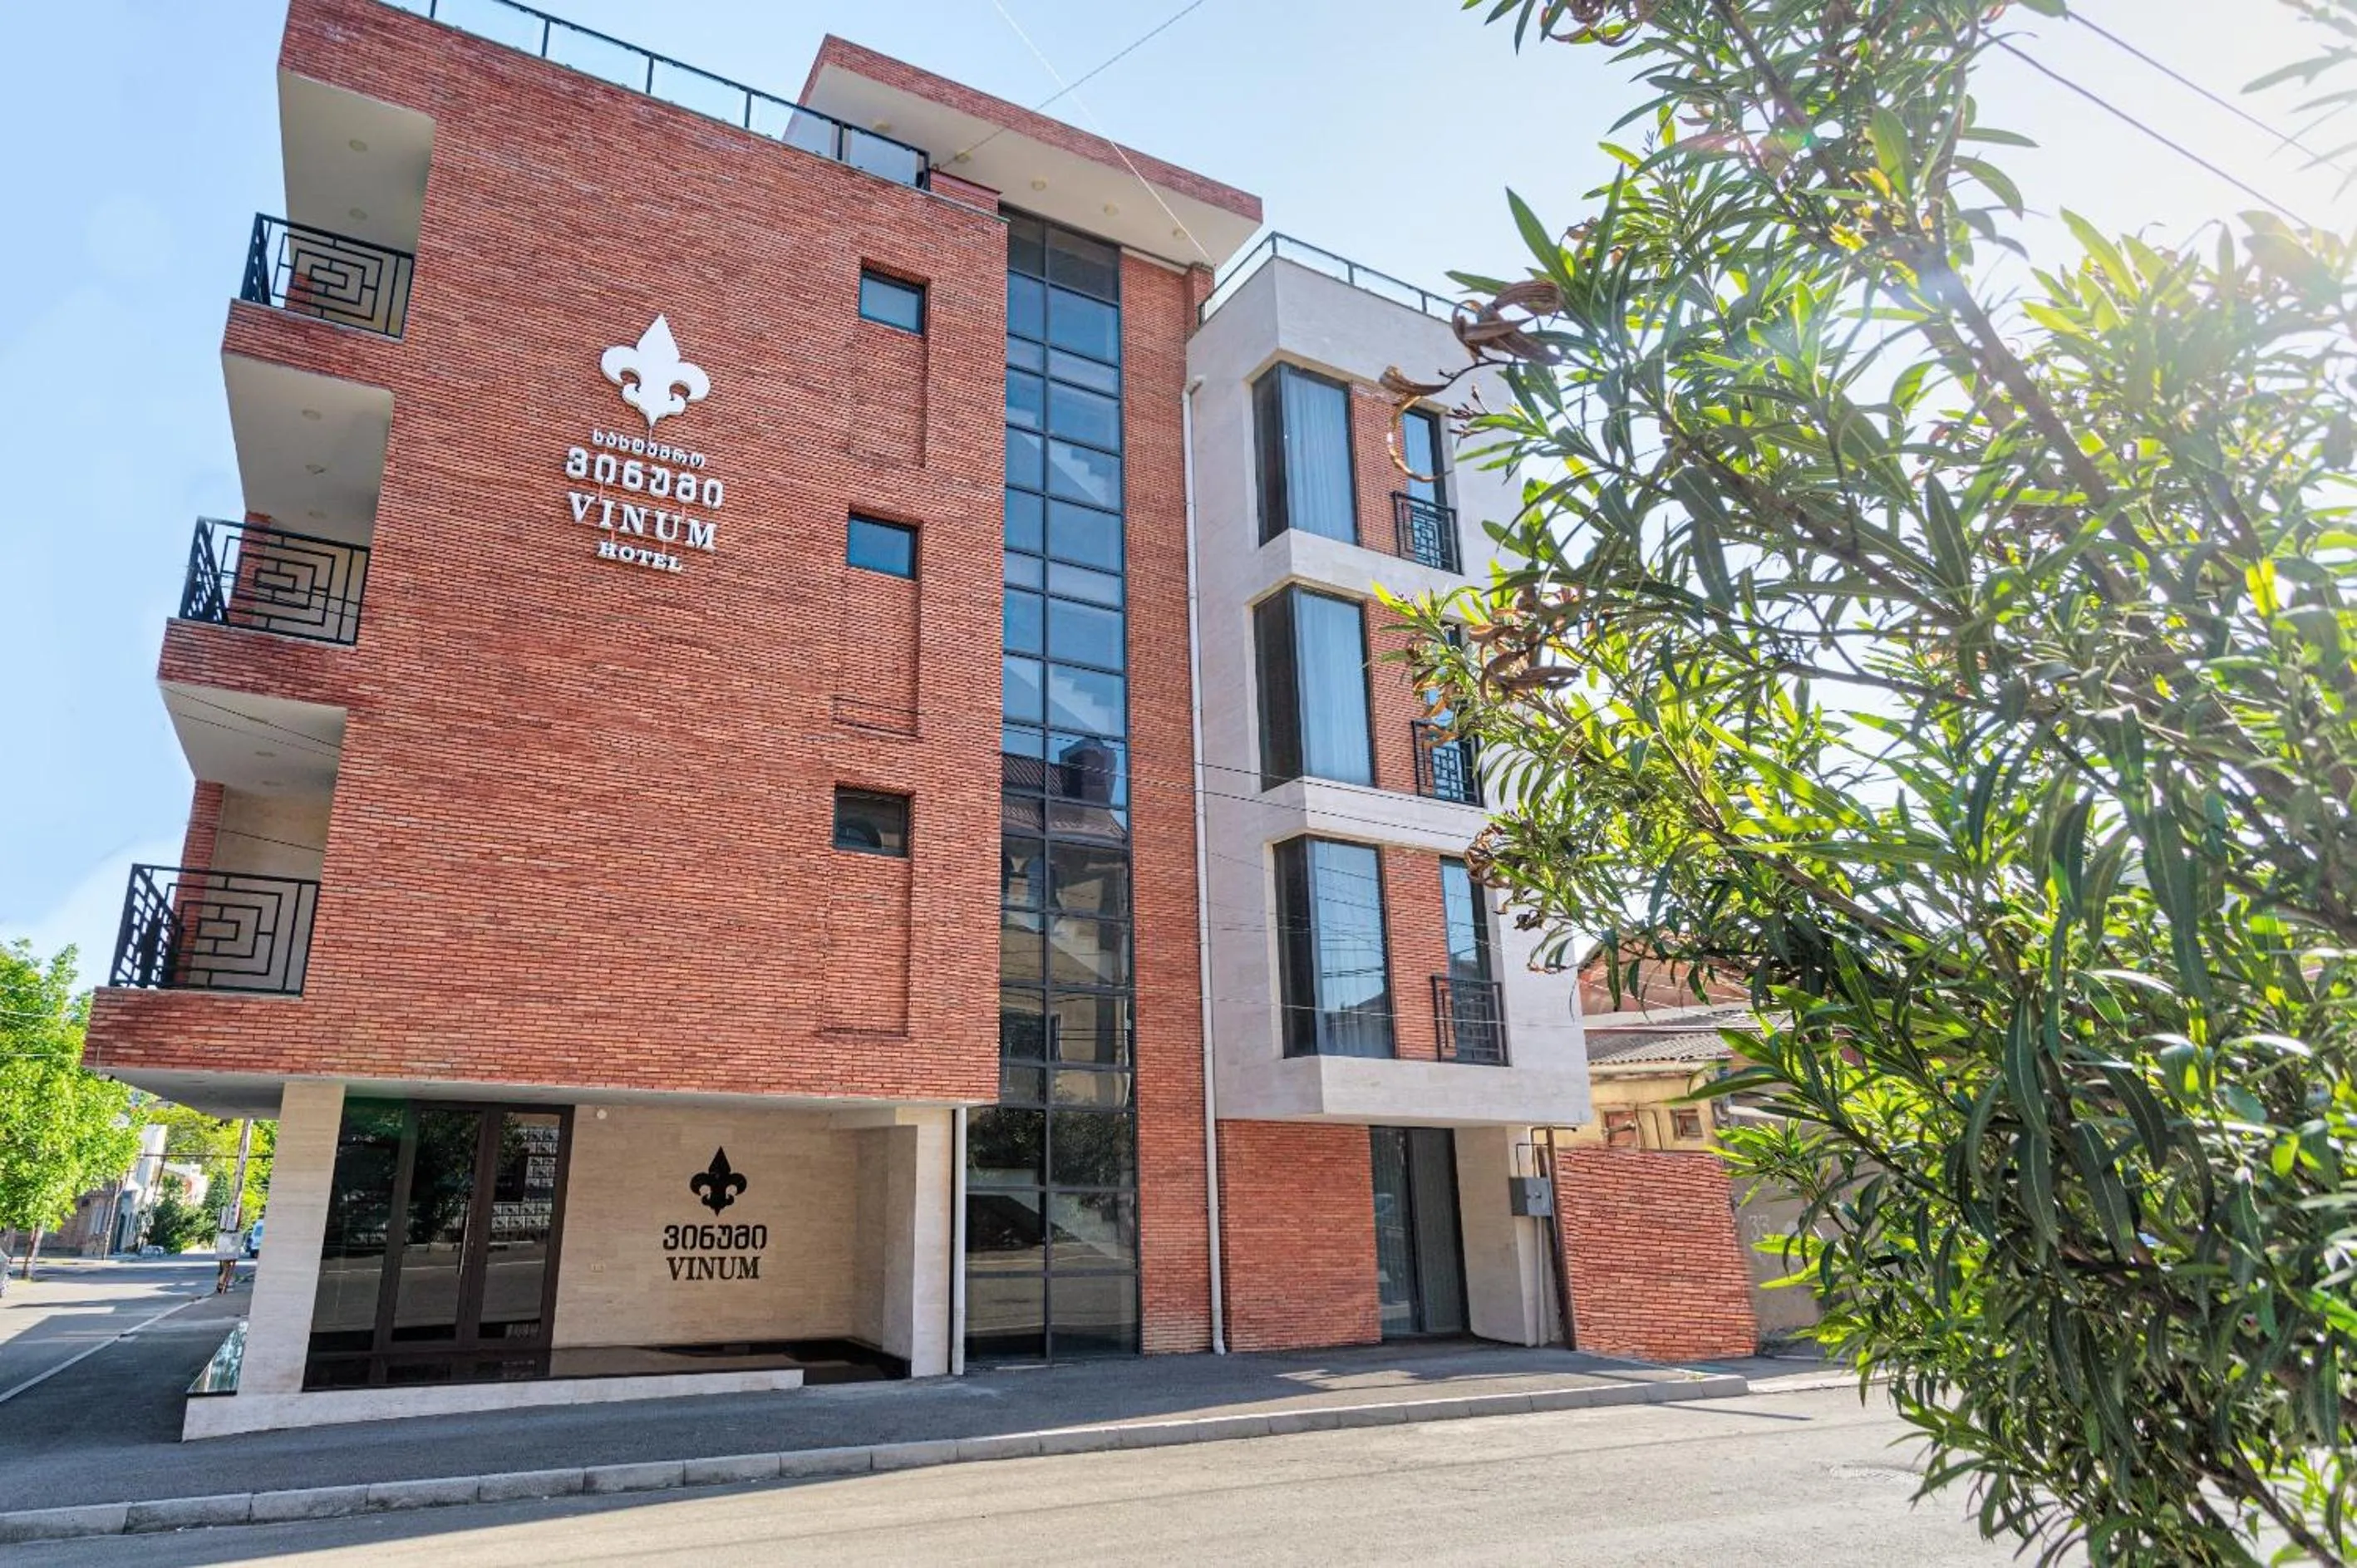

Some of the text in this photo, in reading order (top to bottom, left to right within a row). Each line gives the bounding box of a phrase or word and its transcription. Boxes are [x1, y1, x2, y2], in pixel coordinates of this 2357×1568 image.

[567, 491, 719, 552] VINUM
[597, 540, 683, 572] HOTEL
[666, 1256, 761, 1280] VINUM
